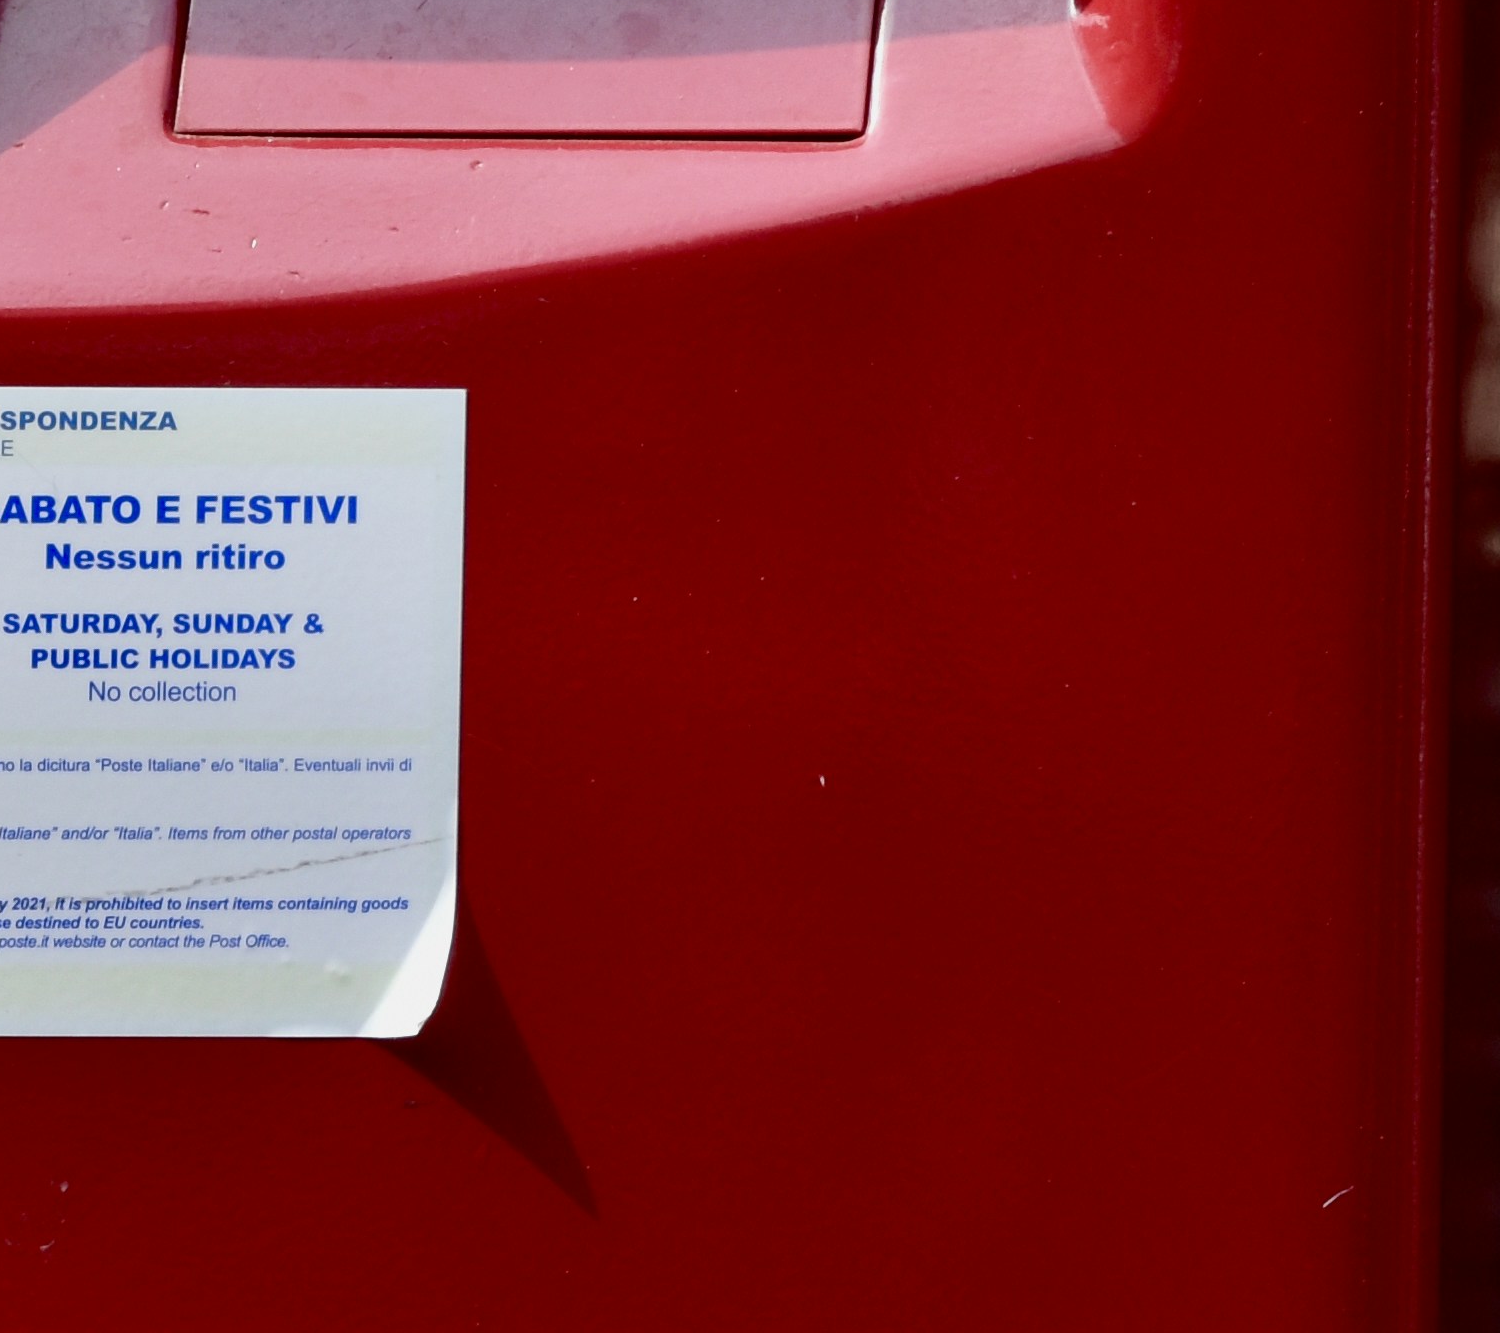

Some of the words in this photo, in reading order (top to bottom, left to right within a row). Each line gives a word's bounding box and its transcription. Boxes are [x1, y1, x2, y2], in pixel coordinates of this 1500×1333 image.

[156, 494, 181, 525] E
[195, 494, 358, 525] FESTIVI
[45, 542, 183, 571] Nessun
[195, 543, 286, 571] ritiro
[2, 612, 163, 639] SATURDAY,
[172, 613, 294, 635] SUNDAY
[303, 612, 325, 635] &
[31, 648, 140, 670] PUBLIC
[149, 648, 296, 670] HOLIDAYS
[88, 680, 122, 703] No
[128, 680, 237, 703] collection
[14, 915, 82, 930] destined
[84, 916, 100, 930] to
[102, 915, 127, 930] EU
[129, 915, 205, 930] countries.
